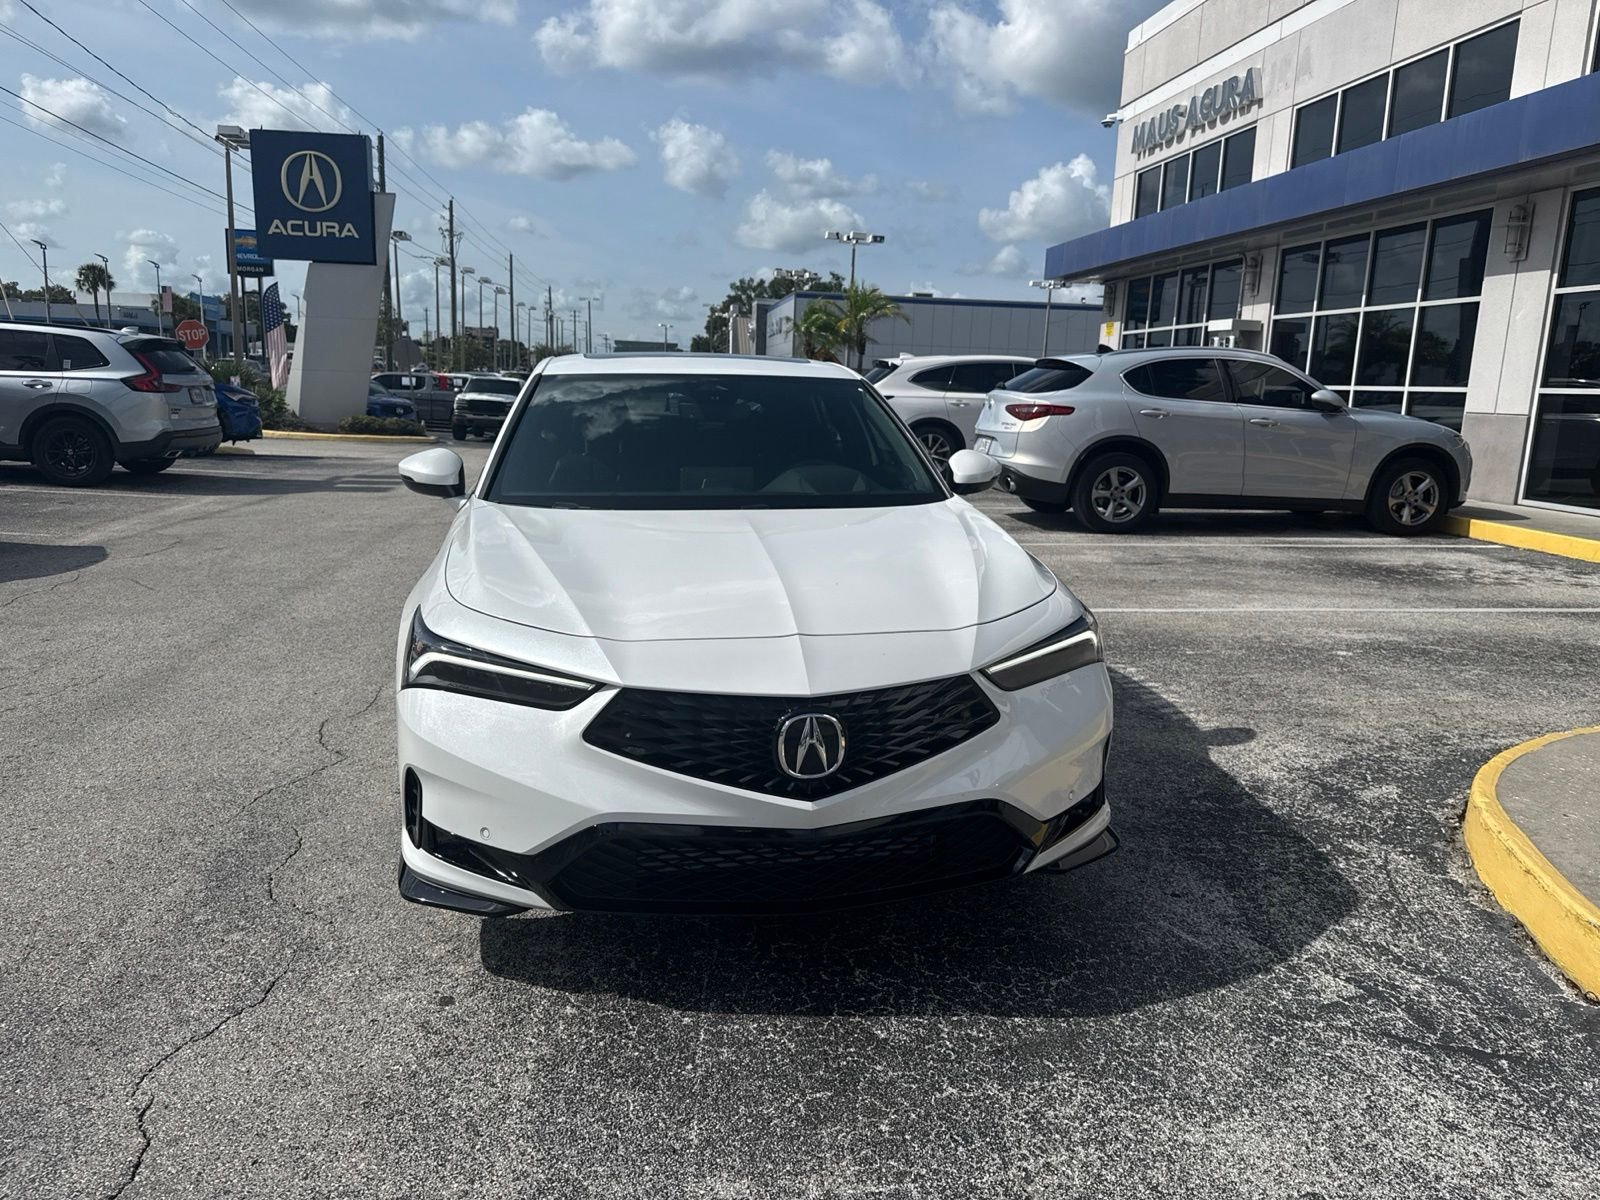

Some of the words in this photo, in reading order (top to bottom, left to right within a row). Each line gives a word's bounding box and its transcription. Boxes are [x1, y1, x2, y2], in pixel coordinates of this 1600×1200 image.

[1131, 104, 1186, 154] MAUS
[1185, 67, 1260, 131] ACURA
[267, 219, 359, 239] ACURA
[178, 329, 206, 341] STOP
